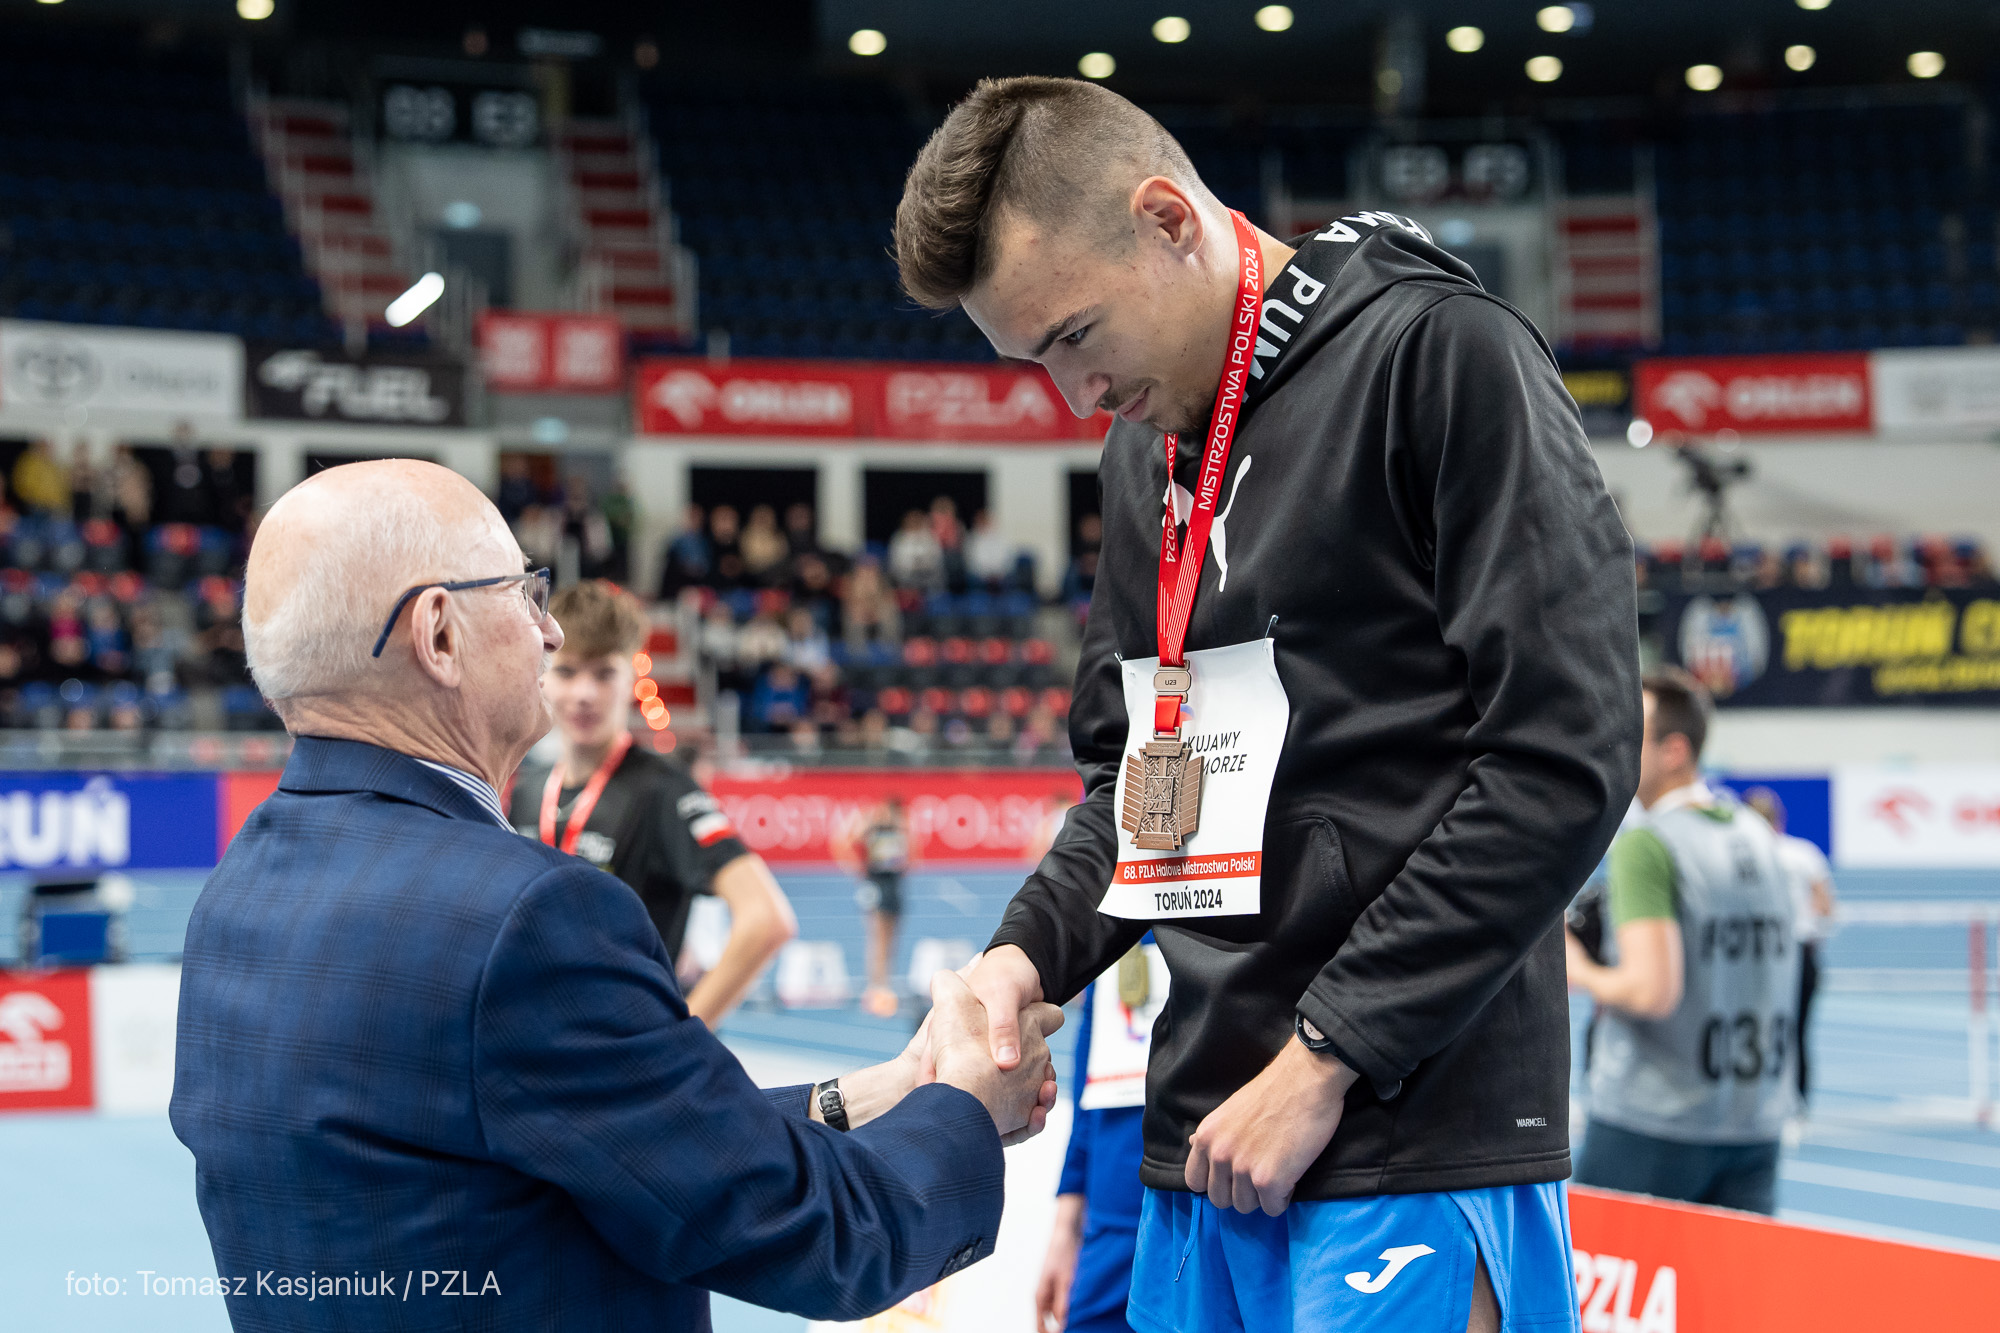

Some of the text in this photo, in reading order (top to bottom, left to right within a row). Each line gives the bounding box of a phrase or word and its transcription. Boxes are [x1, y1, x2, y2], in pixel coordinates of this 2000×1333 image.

[1241, 264, 1327, 403] PUM
[886, 371, 1058, 427] PZLA
[1198, 247, 1259, 511] MISTRZOSTWA POLSKI 2024
[1165, 516, 1176, 563] 2024
[1187, 731, 1241, 752] KUJAWY
[0, 774, 131, 868] UŃ
[1123, 856, 1256, 879] 68. PZLA Halowe Mistrzostwa Polski
[1155, 885, 1222, 911] TORUŃ 2024
[1516, 1117, 1548, 1128] WARMCELL
[1572, 1249, 1678, 1333] PZLA
